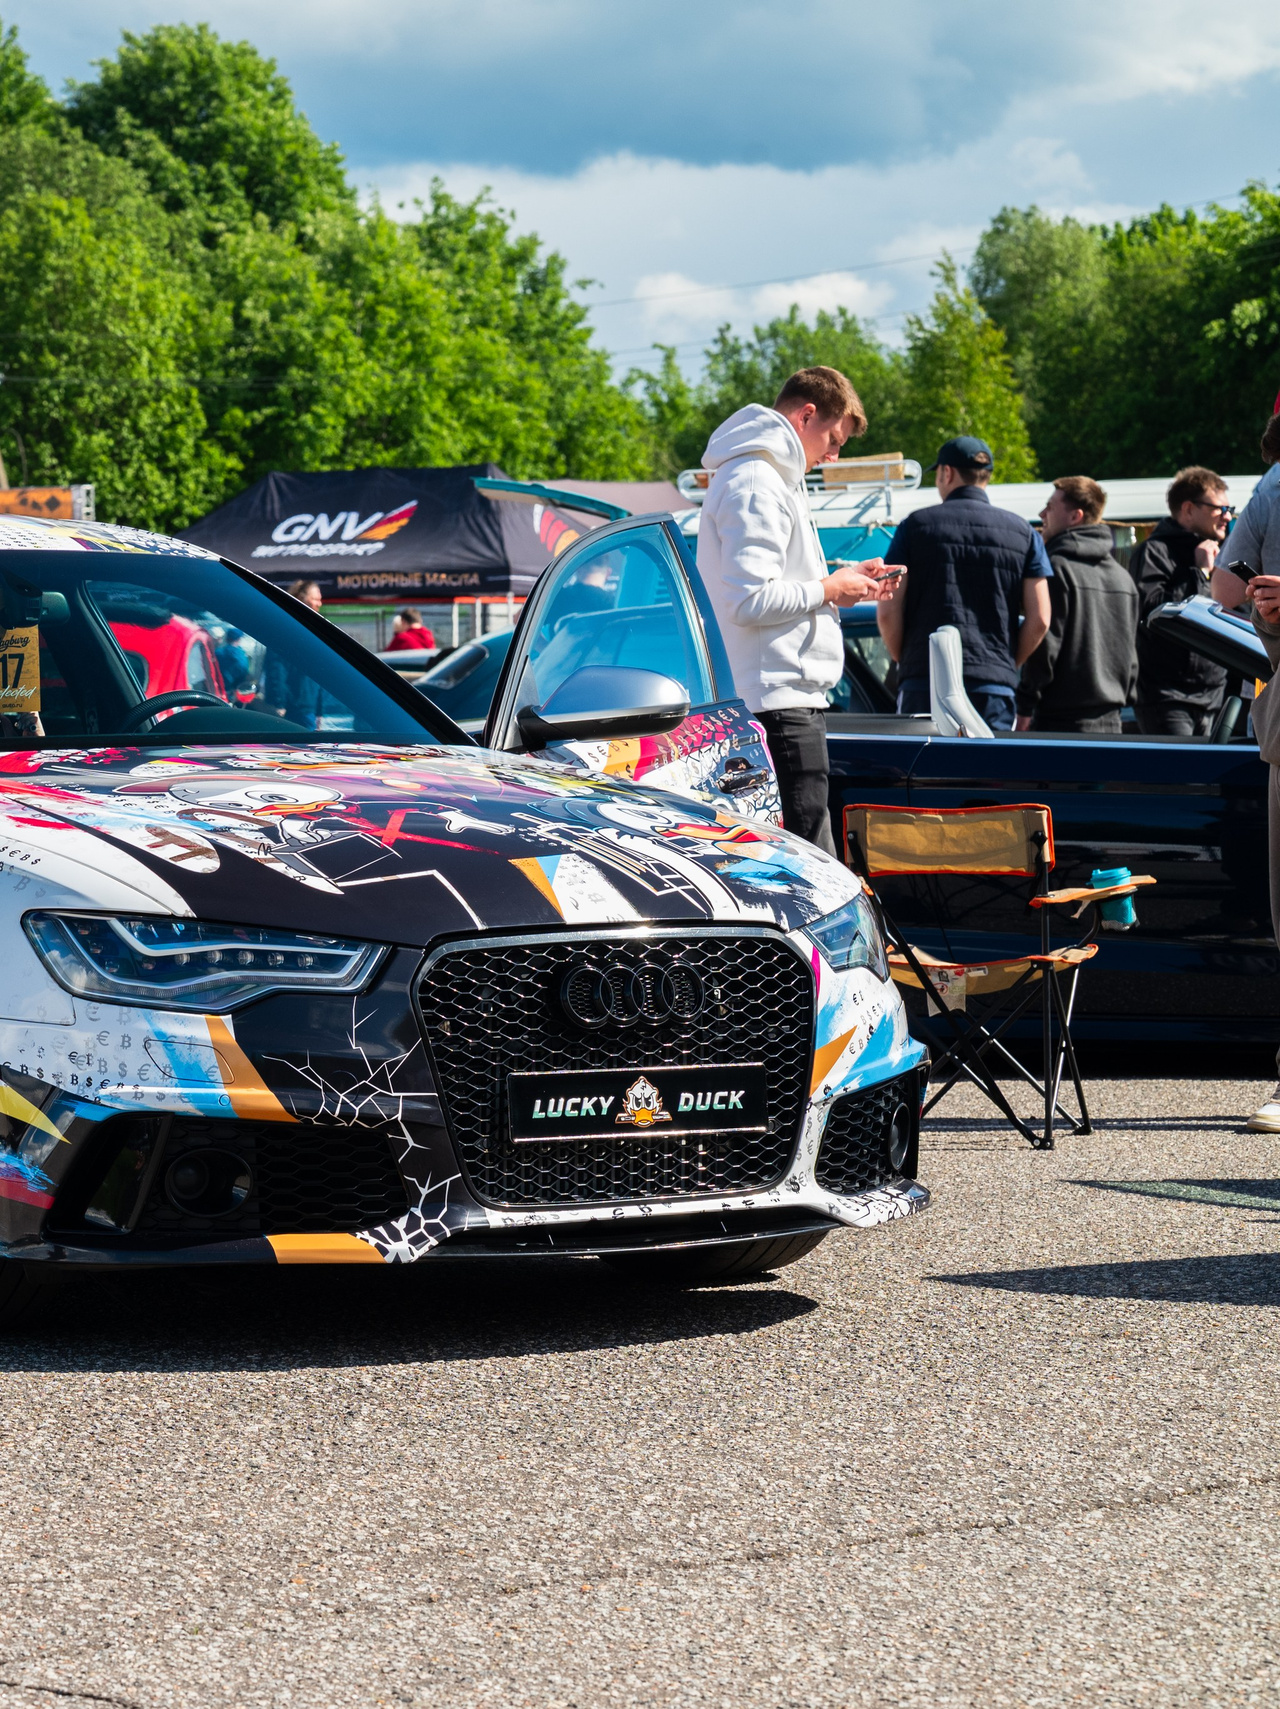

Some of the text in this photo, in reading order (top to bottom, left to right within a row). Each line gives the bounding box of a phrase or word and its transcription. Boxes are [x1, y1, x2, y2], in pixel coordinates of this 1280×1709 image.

[271, 511, 386, 543] GNV
[336, 571, 481, 589] МОТОРНЫЕ МАСЛА
[531, 1090, 746, 1119] LUCKY DUCK
